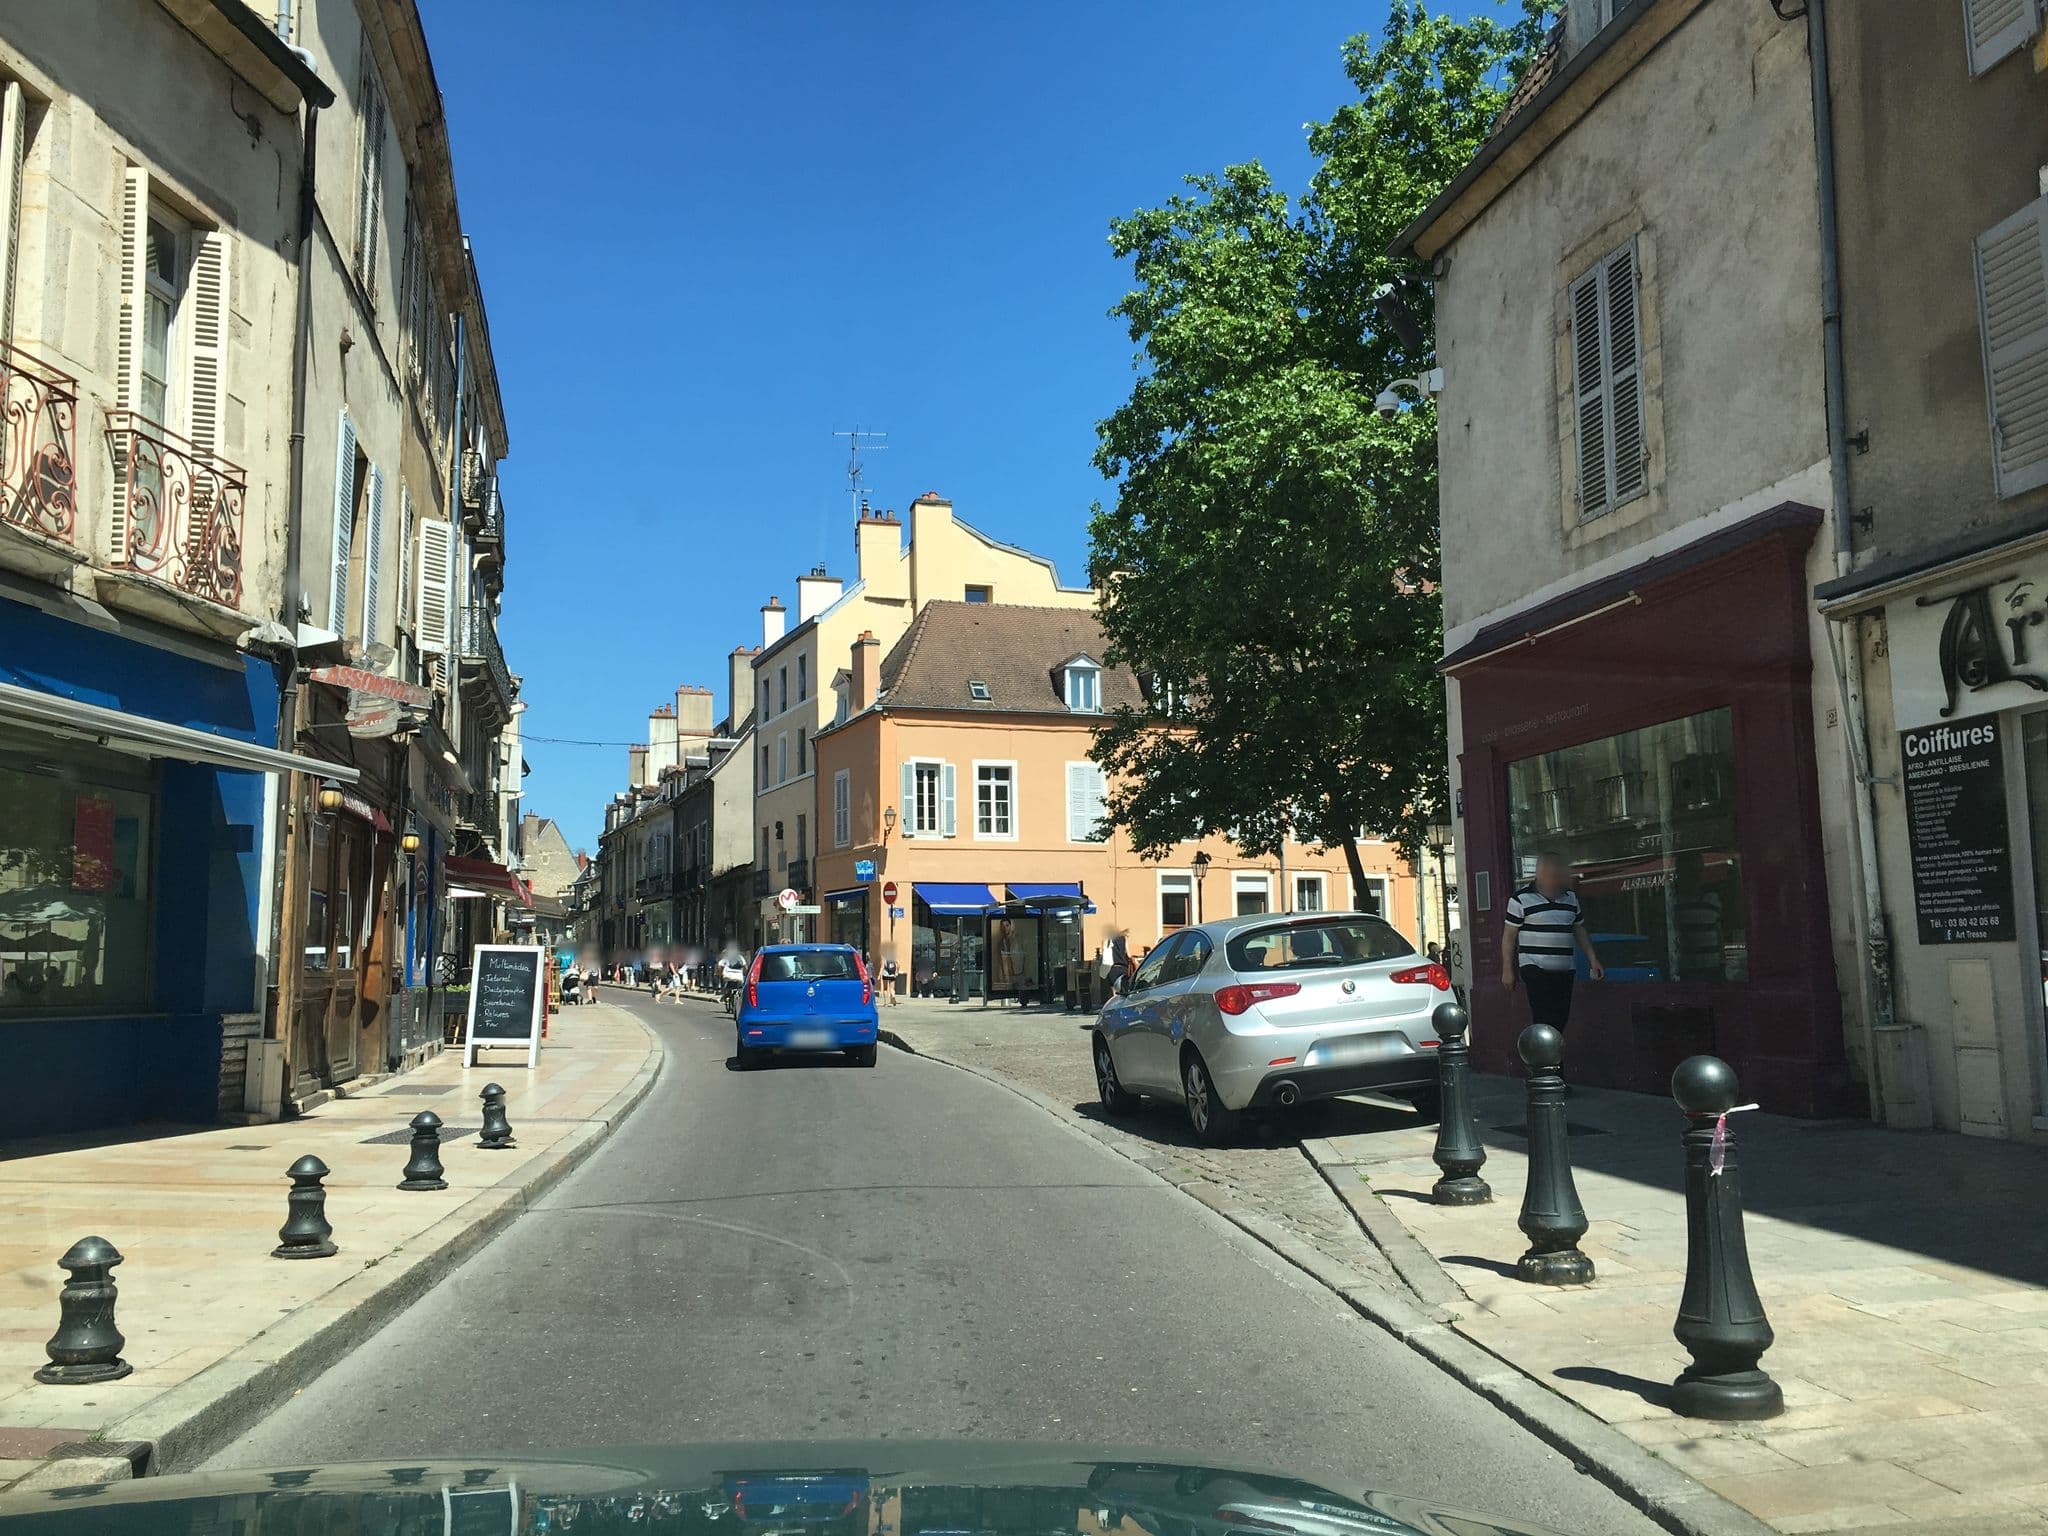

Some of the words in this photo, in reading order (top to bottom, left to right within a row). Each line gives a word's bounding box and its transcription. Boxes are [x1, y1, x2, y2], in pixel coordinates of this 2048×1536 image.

[1904, 724, 1994, 757] Coiffures
[1907, 761, 1923, 770] AFRO
[1928, 755, 1962, 767] ANTILLAISE
[1908, 767, 1943, 779] AMERICANO
[1947, 918, 1957, 927] 03
[1958, 917, 1967, 927] 80
[1968, 917, 1978, 926] 42
[1978, 916, 1988, 925] 05
[1989, 915, 1999, 925] 68
[1955, 930, 1965, 938] Art
[1966, 929, 1987, 938] Tresse
[485, 974, 512, 982] Internet
